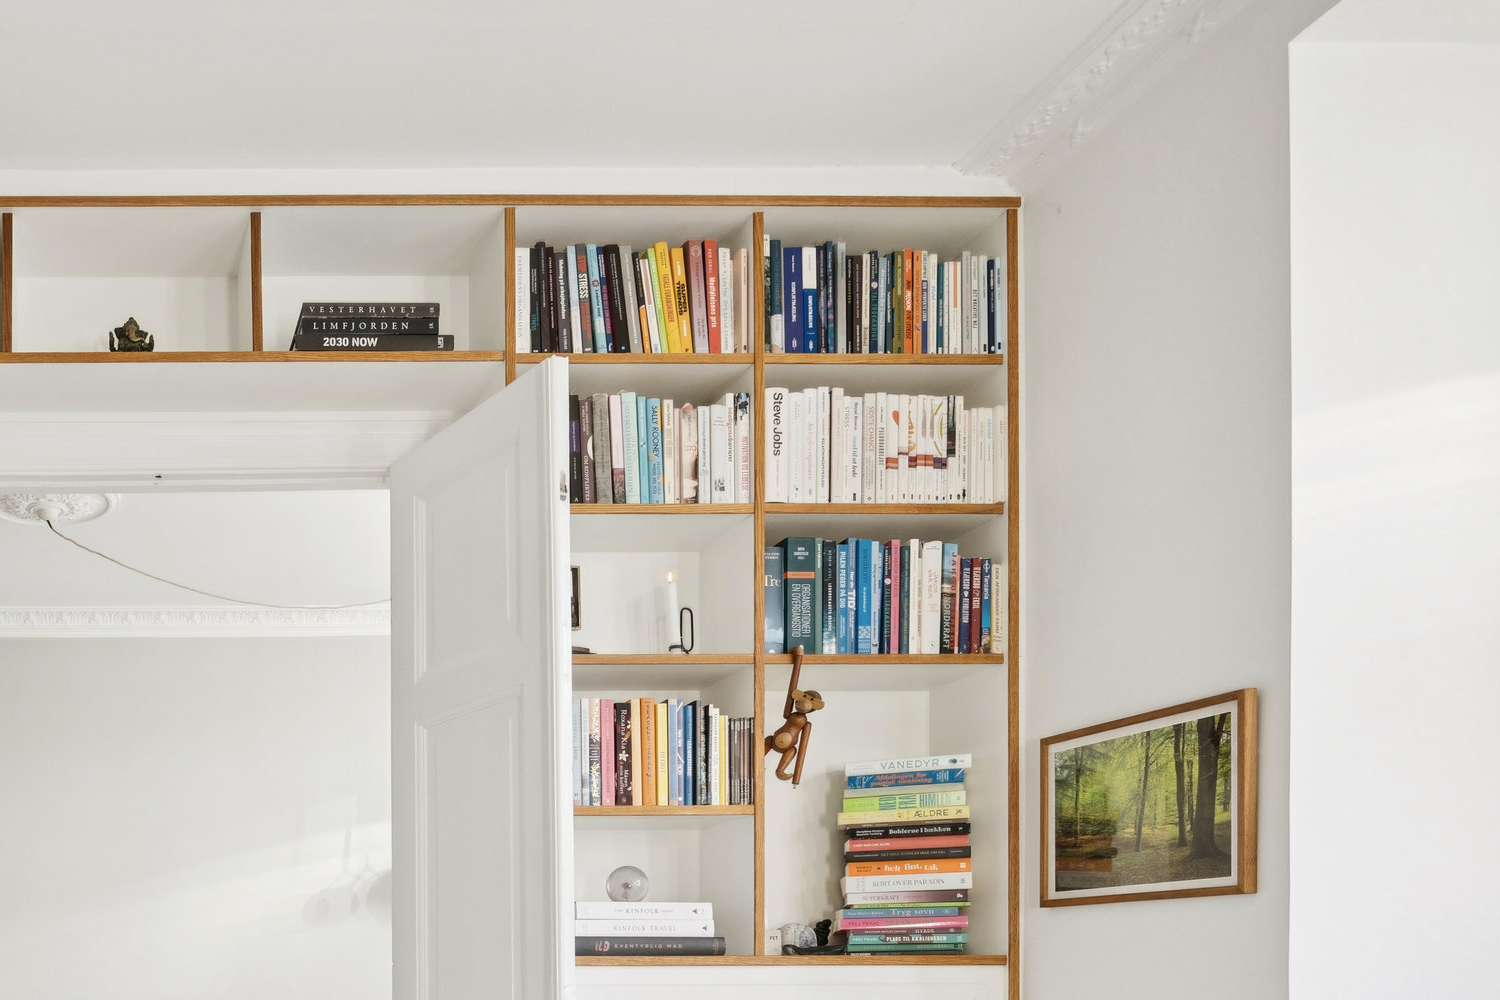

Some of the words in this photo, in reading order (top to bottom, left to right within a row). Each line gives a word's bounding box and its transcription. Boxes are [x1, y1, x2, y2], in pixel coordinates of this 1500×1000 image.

[579, 273, 588, 298] STRESS
[676, 281, 684, 316] TRENDS
[323, 337, 349, 347] 2030
[351, 337, 378, 347] NOW
[651, 405, 659, 425] SALLY
[773, 392, 783, 426] Steve
[652, 426, 660, 458] ROONEY
[773, 427, 783, 456] Jobs
[839, 551, 847, 568] PILEN
[792, 583, 801, 592] EN
[839, 589, 847, 597] PÅ
[791, 592, 801, 637] OVERGANGSTID
[801, 583, 811, 634] ORGANISATIONER
[942, 597, 951, 649] NORDKRAFT
[620, 709, 628, 736] Roxana
[880, 759, 940, 770] VANEDYR
[890, 908, 911, 916] Tryg
[594, 940, 610, 952] ILD
